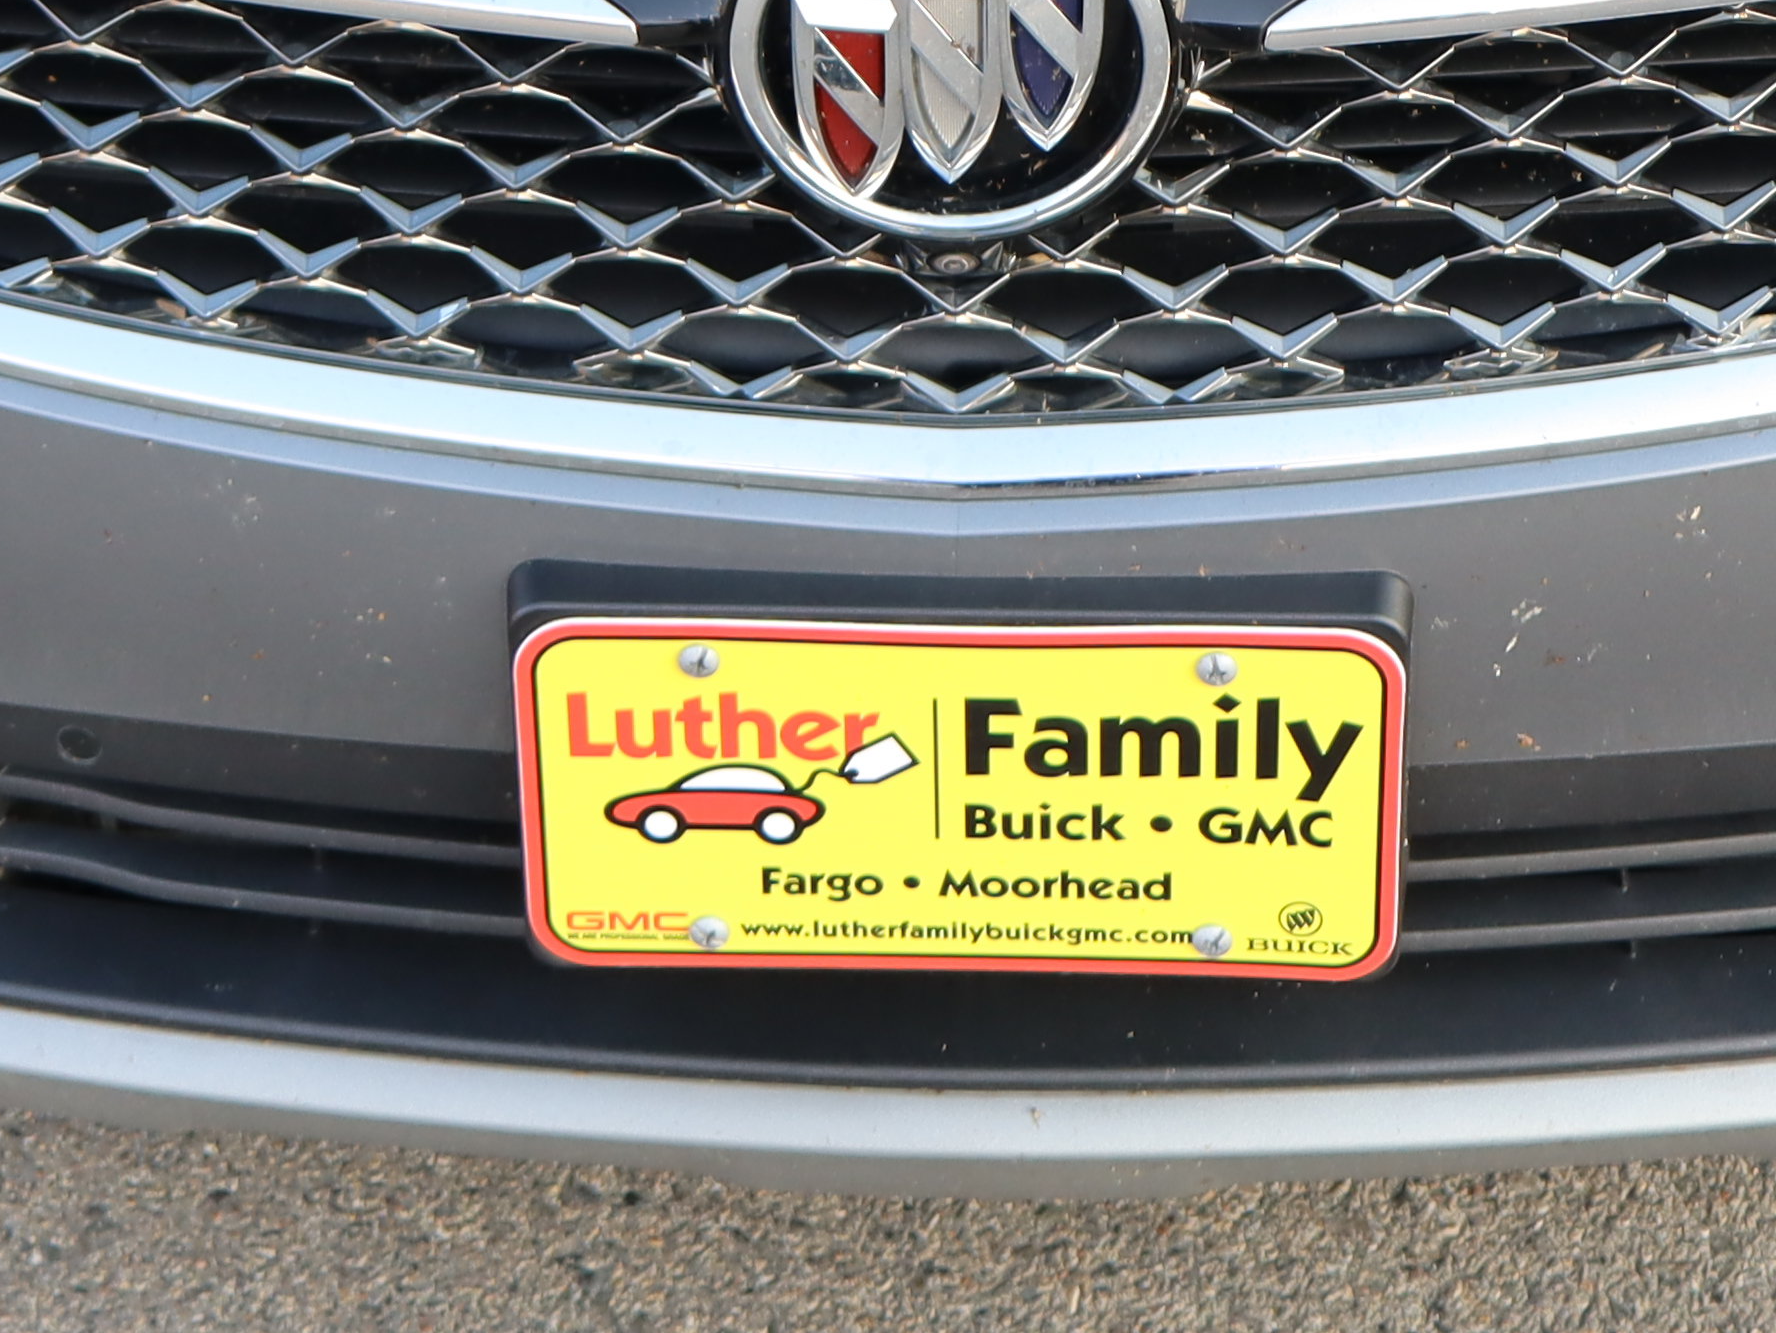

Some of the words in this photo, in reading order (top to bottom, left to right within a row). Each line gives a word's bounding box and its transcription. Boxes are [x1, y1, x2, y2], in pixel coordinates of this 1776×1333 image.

[565, 691, 880, 762] Luther
[963, 694, 1364, 802] Family
[963, 803, 1125, 842] Buick
[1197, 806, 1333, 849] GMC
[761, 866, 884, 903] Fargo
[938, 870, 1173, 902] Moorhead
[566, 910, 690, 932] GMC
[741, 920, 1194, 946] www.lutherfamilybuickgmc.com
[1246, 937, 1354, 956] BUICK
